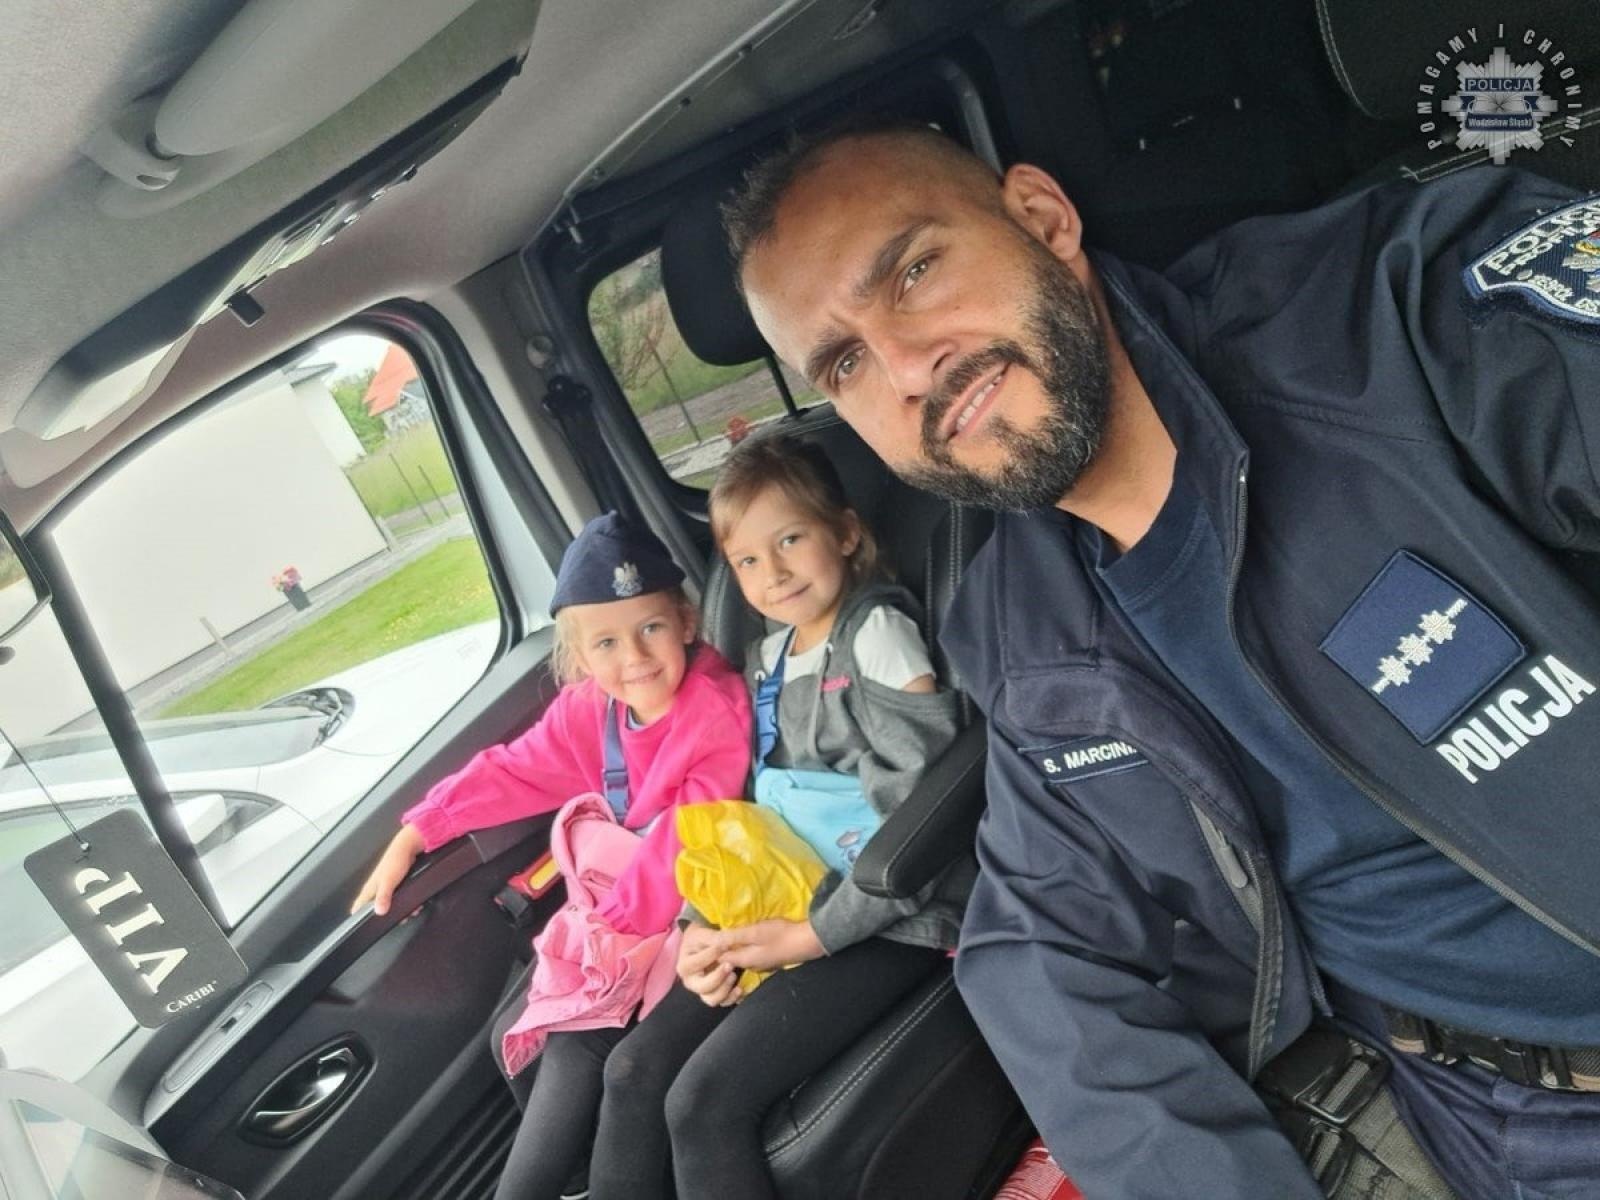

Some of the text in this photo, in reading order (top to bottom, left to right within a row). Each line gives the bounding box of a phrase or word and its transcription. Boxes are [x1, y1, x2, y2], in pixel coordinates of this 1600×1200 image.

[1043, 741, 1137, 774] S. MARCIN
[1436, 654, 1597, 785] POLICJA
[73, 867, 189, 995] VIP
[167, 983, 215, 1012] CARIBI
